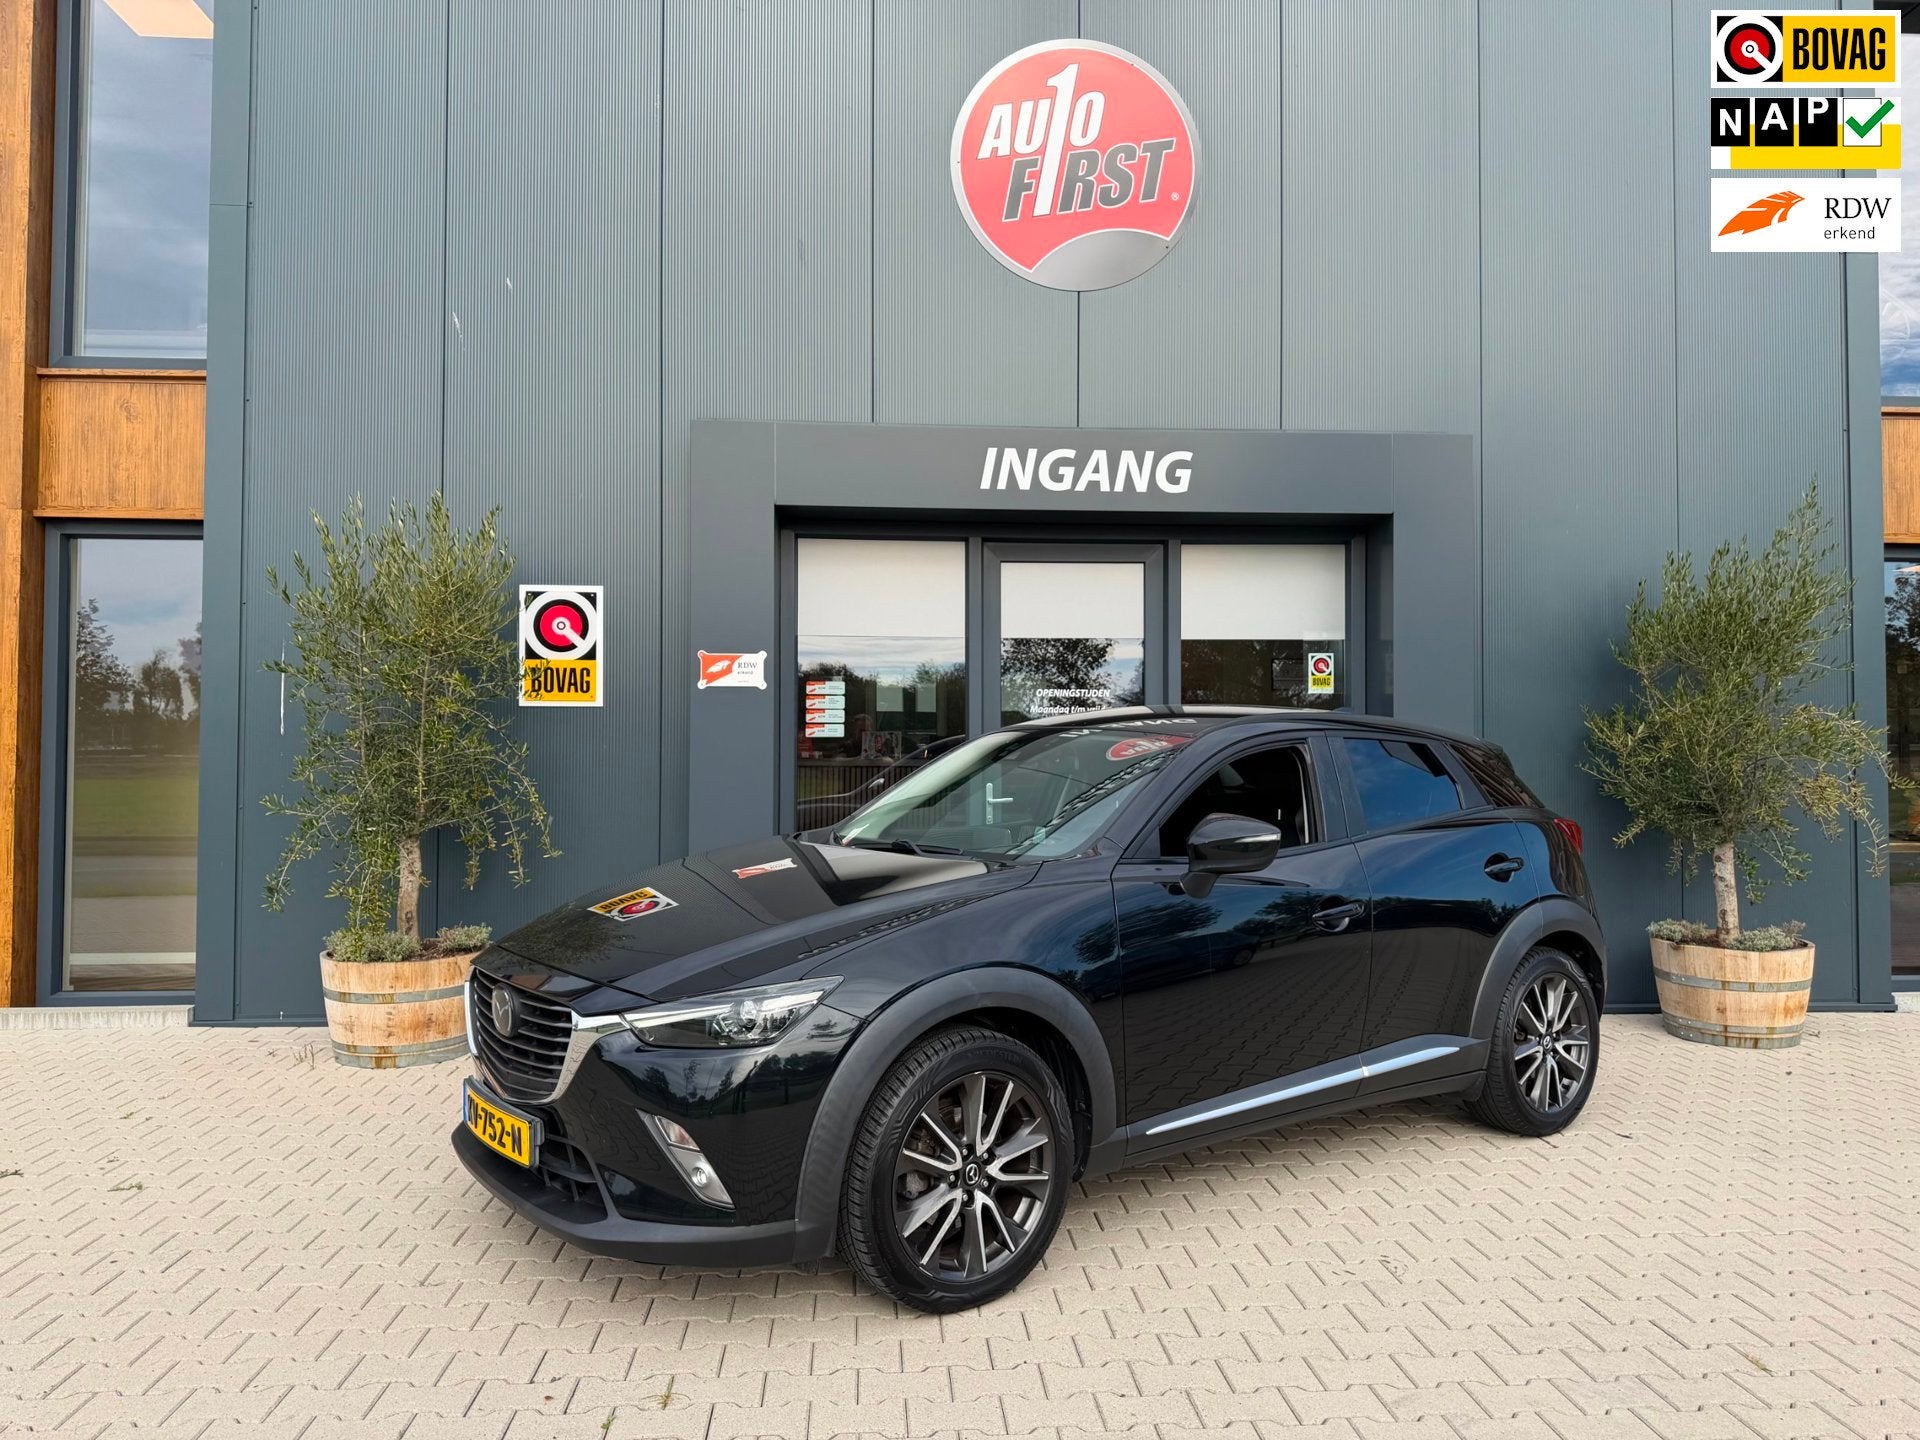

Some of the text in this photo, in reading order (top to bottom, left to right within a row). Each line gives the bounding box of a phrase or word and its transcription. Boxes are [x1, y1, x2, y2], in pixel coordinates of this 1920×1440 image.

[980, 447, 1194, 494] INGANG
[737, 661, 758, 669] RDW
[531, 667, 591, 694] BOVAG
[1312, 677, 1331, 686] BOVAG
[1036, 688, 1111, 698] OPENINGSTIJDEN
[1071, 705, 1086, 713] t/m
